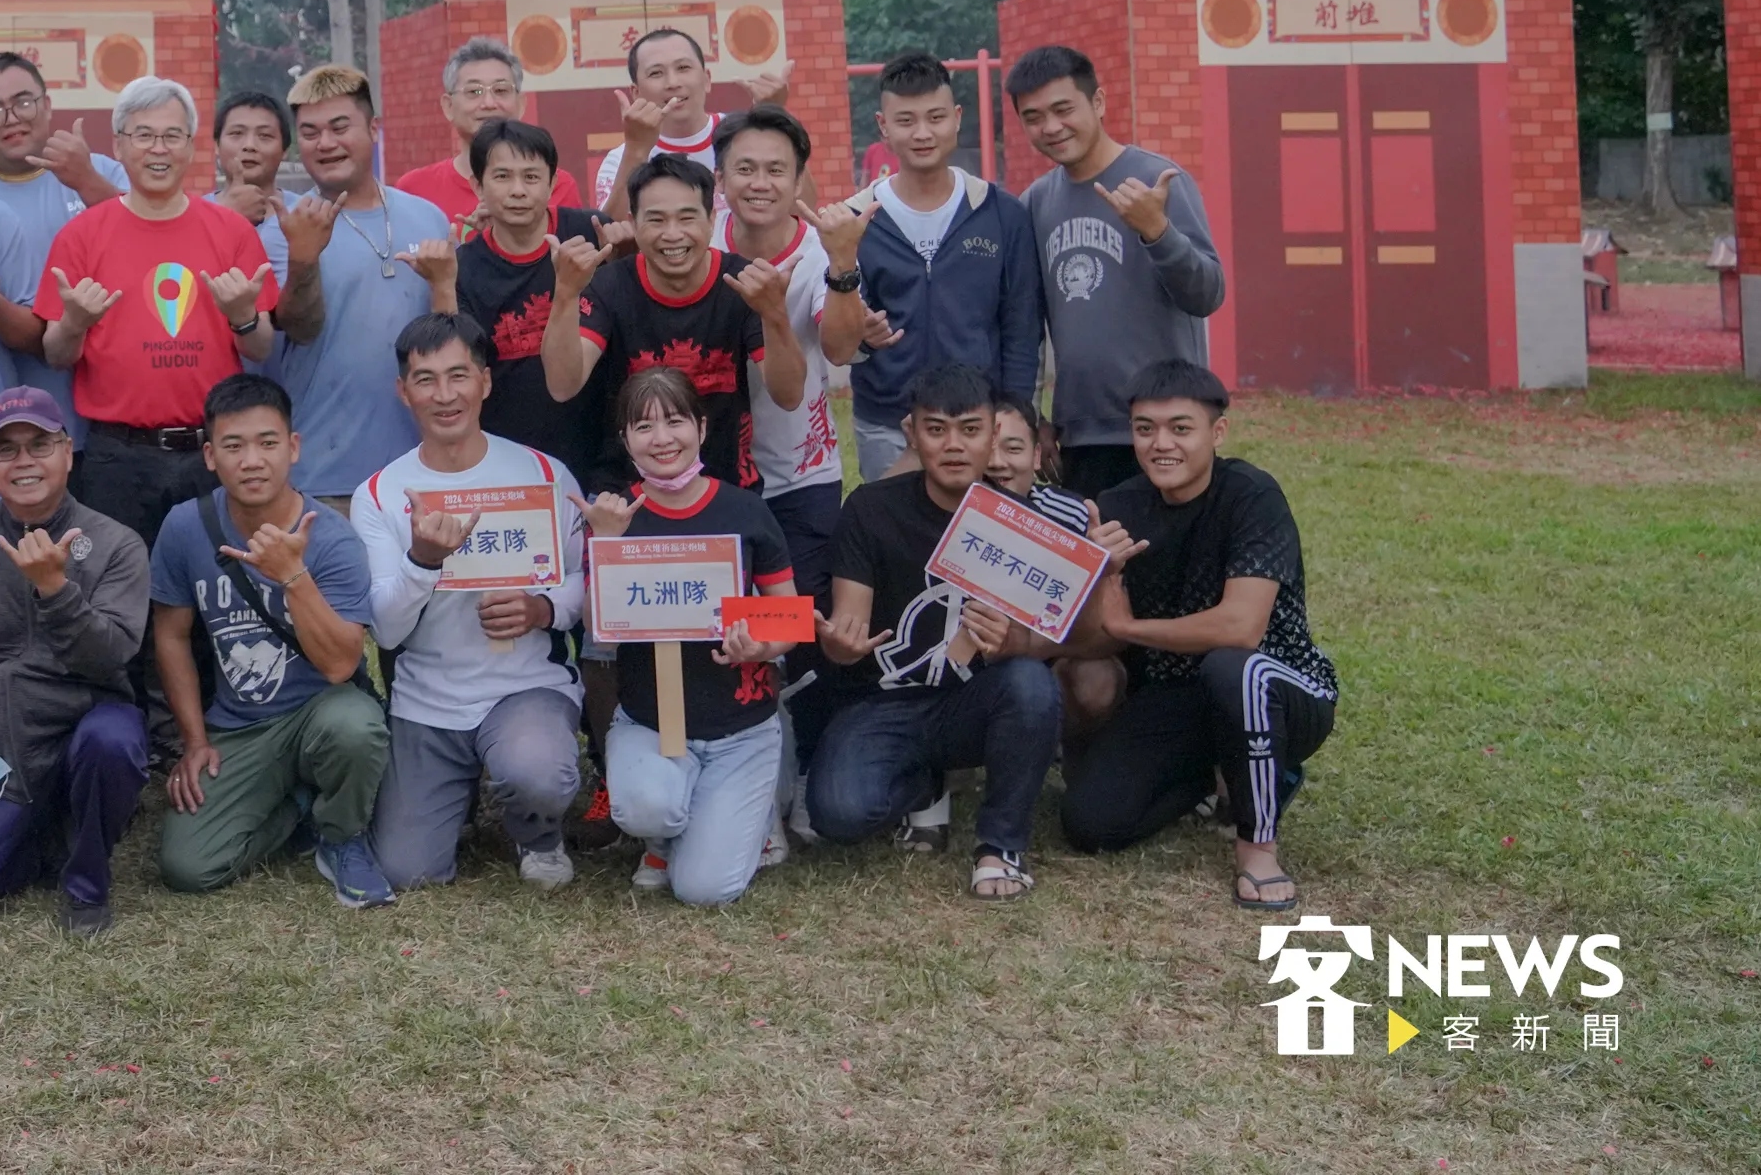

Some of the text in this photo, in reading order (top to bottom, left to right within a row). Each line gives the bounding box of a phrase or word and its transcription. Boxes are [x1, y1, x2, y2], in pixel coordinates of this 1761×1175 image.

[1315, 0, 1379, 30] 前堆
[962, 236, 999, 254] BOSS
[1061, 216, 1123, 265] ANGELES
[142, 340, 205, 352] PINGTUNG
[151, 354, 199, 369] LIUDUI
[444, 494, 463, 505] 2024
[996, 501, 1016, 518] 2024
[621, 544, 640, 554] 2024
[961, 531, 1070, 602] 不醉不回家
[196, 575, 294, 625] ROT
[626, 580, 708, 606] 九洲隊
[229, 609, 263, 624] CANA
